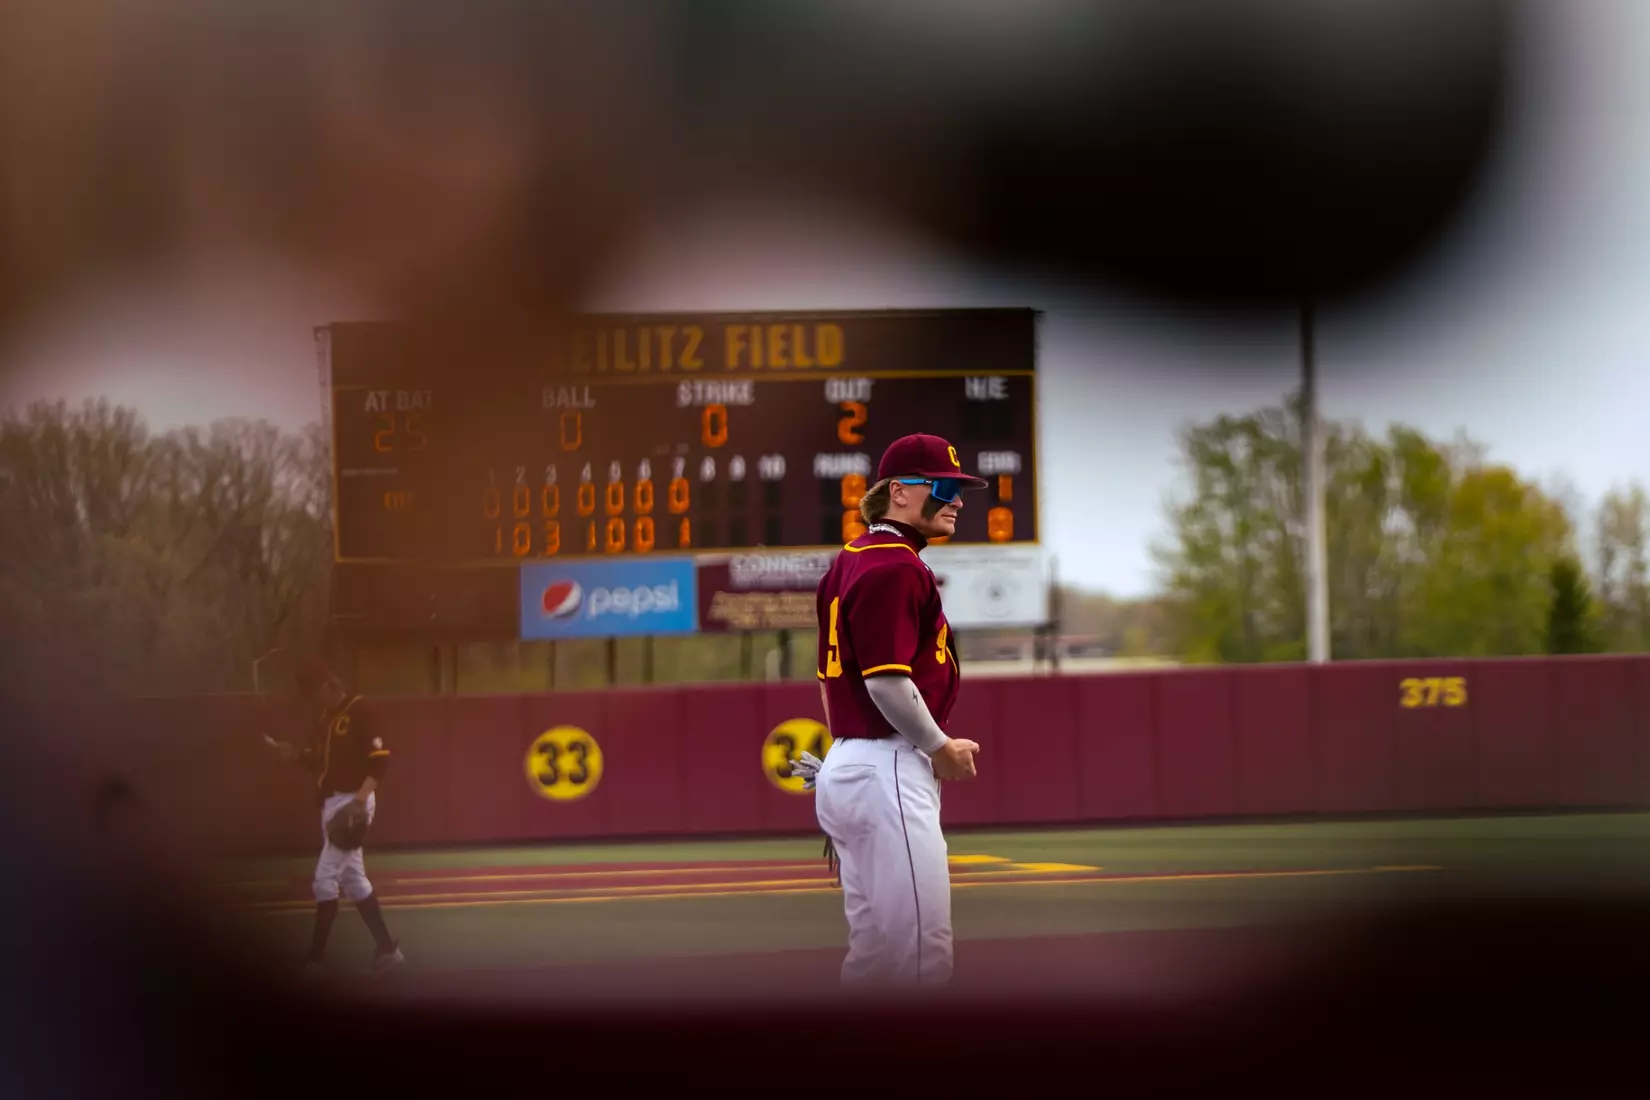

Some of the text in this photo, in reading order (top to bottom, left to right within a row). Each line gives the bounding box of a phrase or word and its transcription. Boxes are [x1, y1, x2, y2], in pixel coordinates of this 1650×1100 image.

[725, 324, 844, 368] FIELD
[365, 389, 389, 412] AT
[543, 386, 596, 408] BALL
[677, 379, 755, 406] STRIKE
[825, 378, 873, 402] OUT
[560, 411, 582, 451] 0
[702, 404, 727, 448] 0
[837, 402, 867, 445] 2
[515, 465, 526, 485] 2
[546, 463, 557, 486] 3
[582, 461, 591, 483] 4
[672, 456, 685, 478] 7
[947, 445, 960, 467] C
[513, 485, 530, 517] 0
[543, 484, 560, 516] 0
[577, 482, 595, 516] 0
[605, 480, 624, 516] 0
[634, 479, 653, 515] 0
[668, 477, 689, 515] 0
[513, 522, 530, 556] 0
[605, 517, 625, 553] 0
[634, 516, 654, 552] 0
[680, 516, 690, 549] 1
[588, 579, 679, 619] pepsi
[1400, 678, 1467, 706] 375
[337, 714, 349, 735] C
[538, 741, 590, 787] 33
